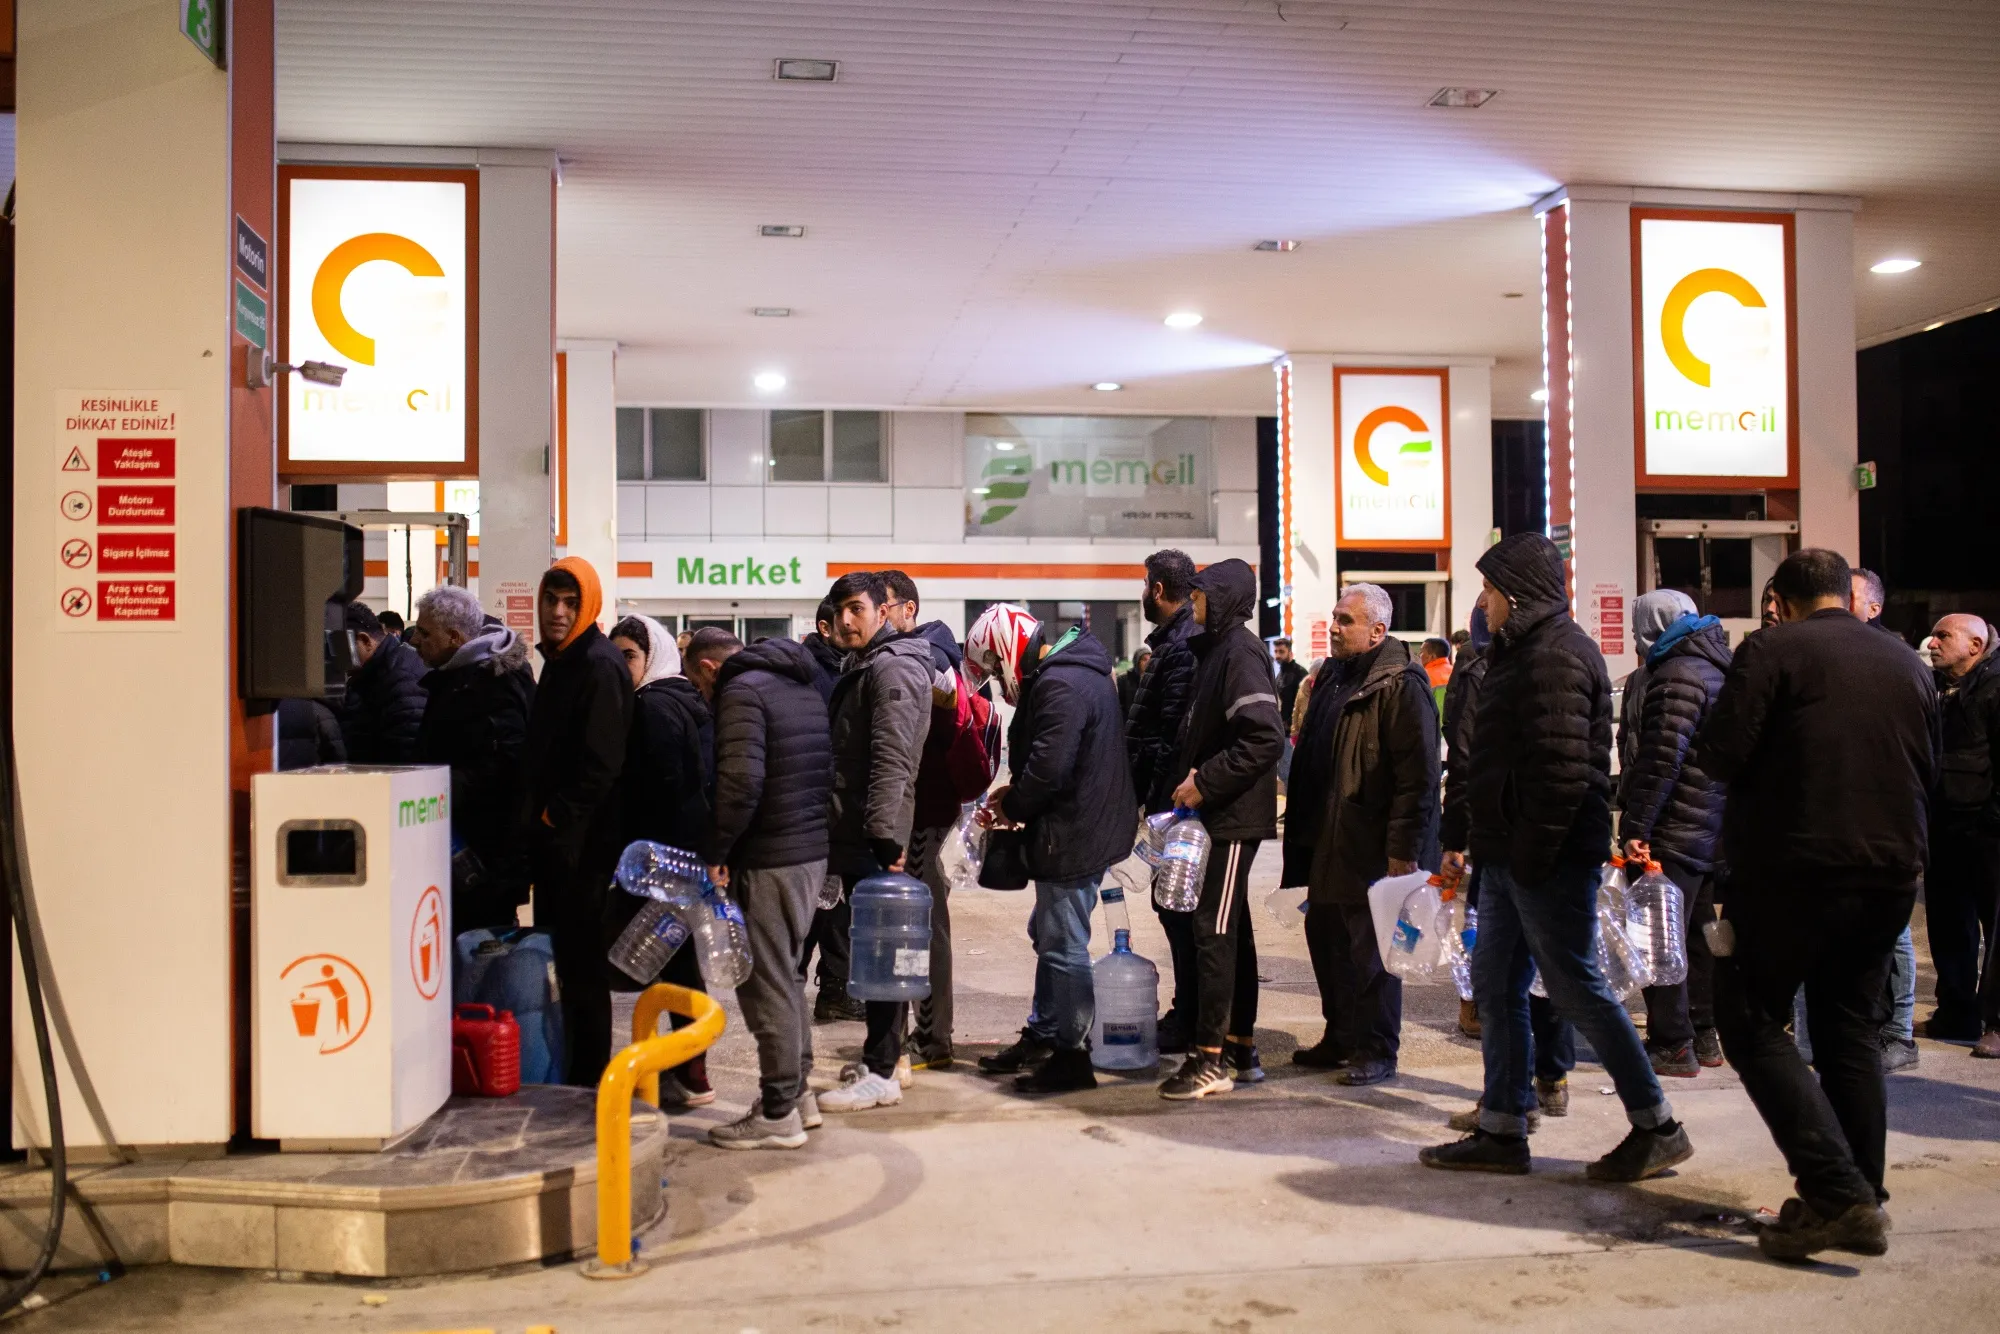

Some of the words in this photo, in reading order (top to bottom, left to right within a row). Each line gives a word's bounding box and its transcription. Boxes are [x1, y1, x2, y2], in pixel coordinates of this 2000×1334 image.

[239, 233, 265, 274] Motorin
[81, 397, 159, 412] KESİNLİKLE
[66, 415, 116, 431] DİKKAT
[121, 412, 175, 431] EDİNİZ!
[121, 448, 152, 459] Ateşle
[113, 460, 160, 471] Yaklaşma
[118, 495, 153, 505] Motoru
[108, 507, 165, 517] Durdurunuz
[103, 548, 134, 560] Sigara
[135, 547, 170, 560] İçilmez
[677, 556, 801, 585] Market
[107, 584, 130, 596] Araç
[132, 586, 144, 594] ve
[146, 584, 166, 596] Cep
